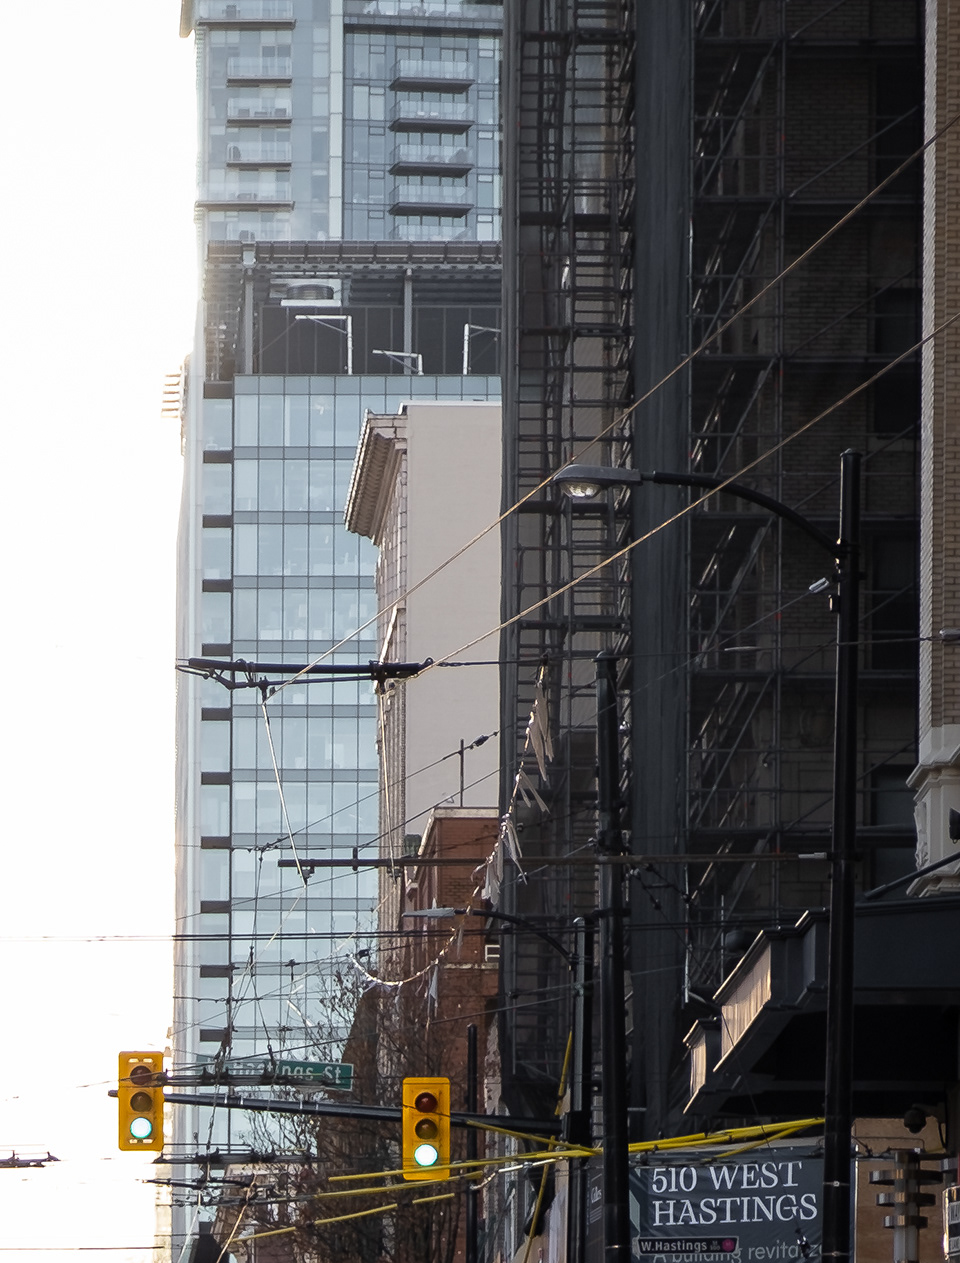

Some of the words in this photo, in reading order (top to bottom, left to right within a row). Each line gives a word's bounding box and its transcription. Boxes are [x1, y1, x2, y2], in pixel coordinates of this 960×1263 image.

[323, 1066, 342, 1084] St
[651, 1166, 698, 1193] 510
[709, 1160, 803, 1191] WEST
[652, 1193, 818, 1227] HASTINGS
[641, 1239, 708, 1253] W.Hastings
[748, 1239, 823, 1260] revitaz
